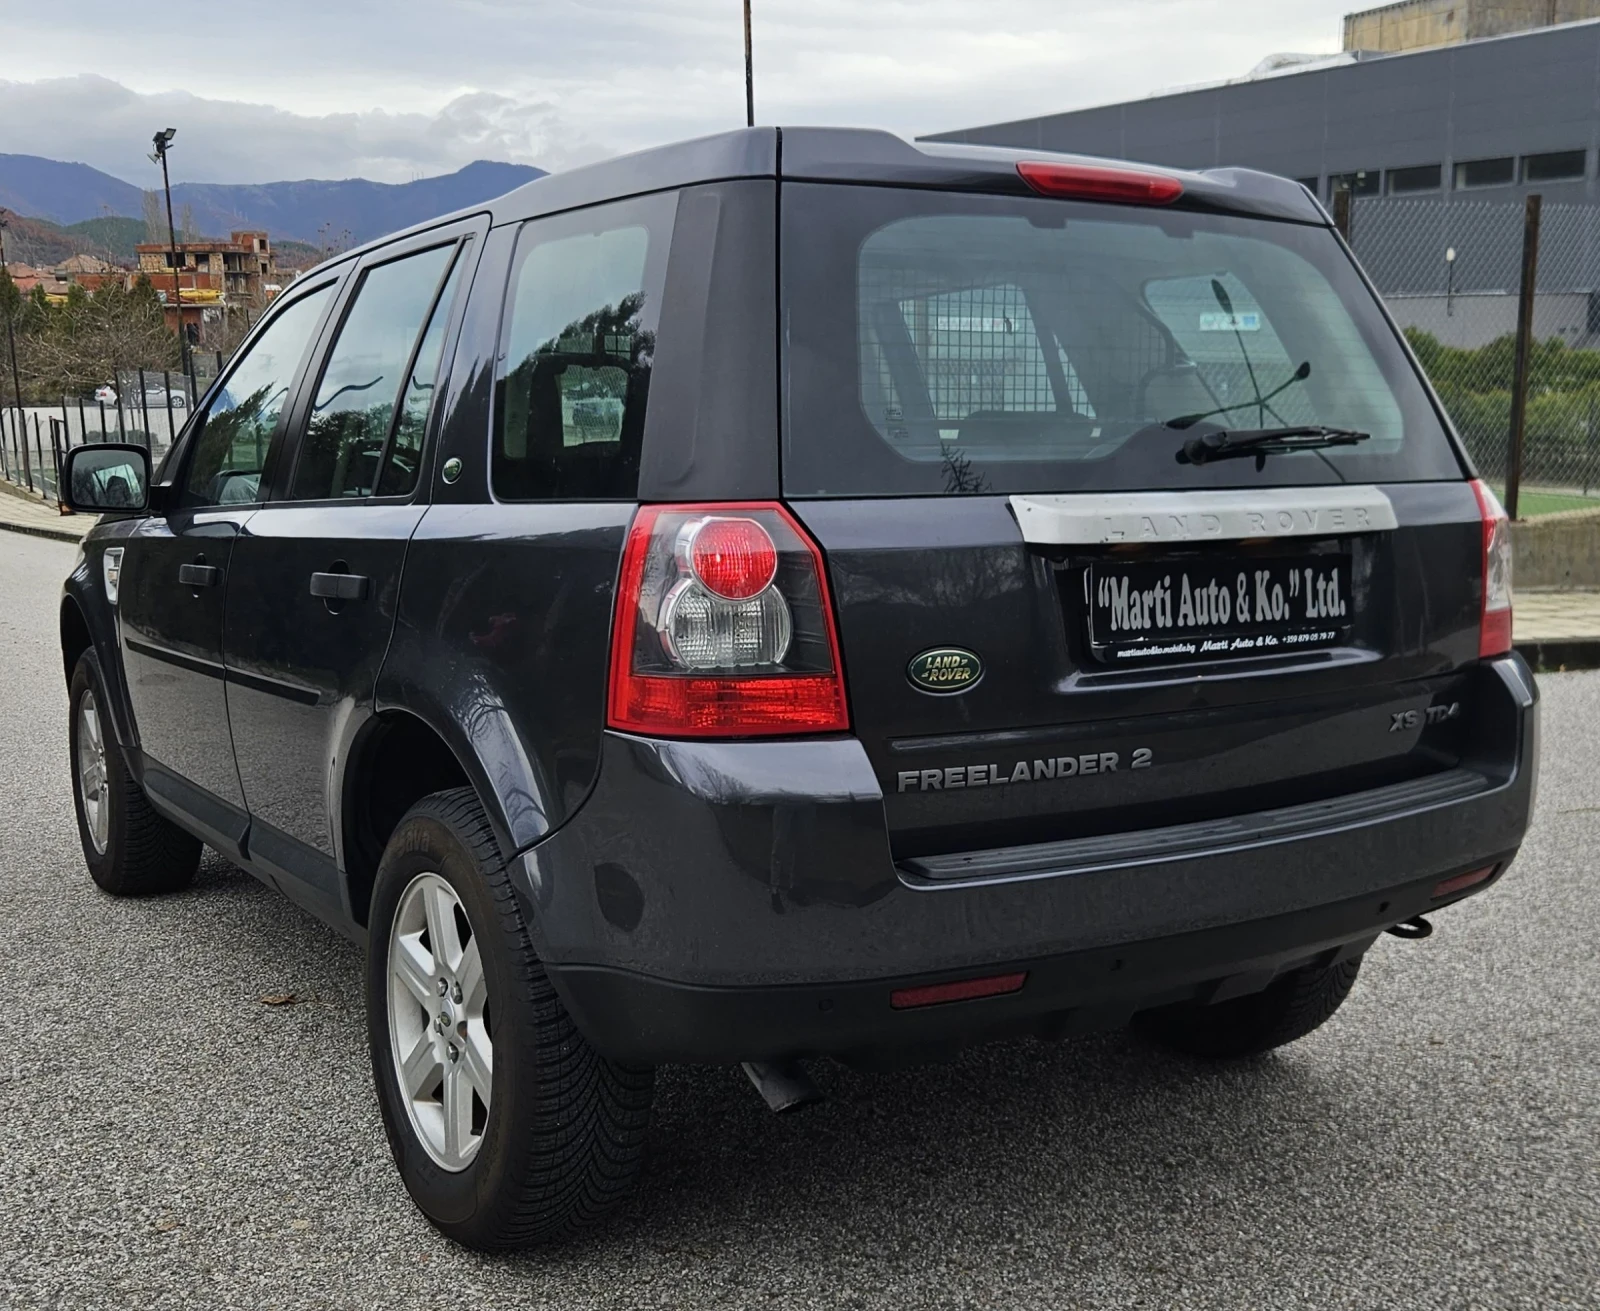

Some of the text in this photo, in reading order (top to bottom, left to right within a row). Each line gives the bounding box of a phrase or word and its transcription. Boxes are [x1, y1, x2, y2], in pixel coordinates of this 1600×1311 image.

[1103, 507, 1373, 541] LAND ROVER
[1178, 573, 1231, 627] Auto
[1236, 572, 1251, 623] &
[1304, 567, 1346, 618] Ltd.
[1200, 639, 1229, 653] Marti
[1230, 637, 1255, 651] Auto
[1256, 636, 1264, 647] &
[1265, 634, 1279, 646] Ko.
[925, 655, 961, 669] LAND
[928, 667, 972, 682] ROVER
[1389, 710, 1418, 732] XS
[897, 747, 1153, 793] FREELANDER 2
